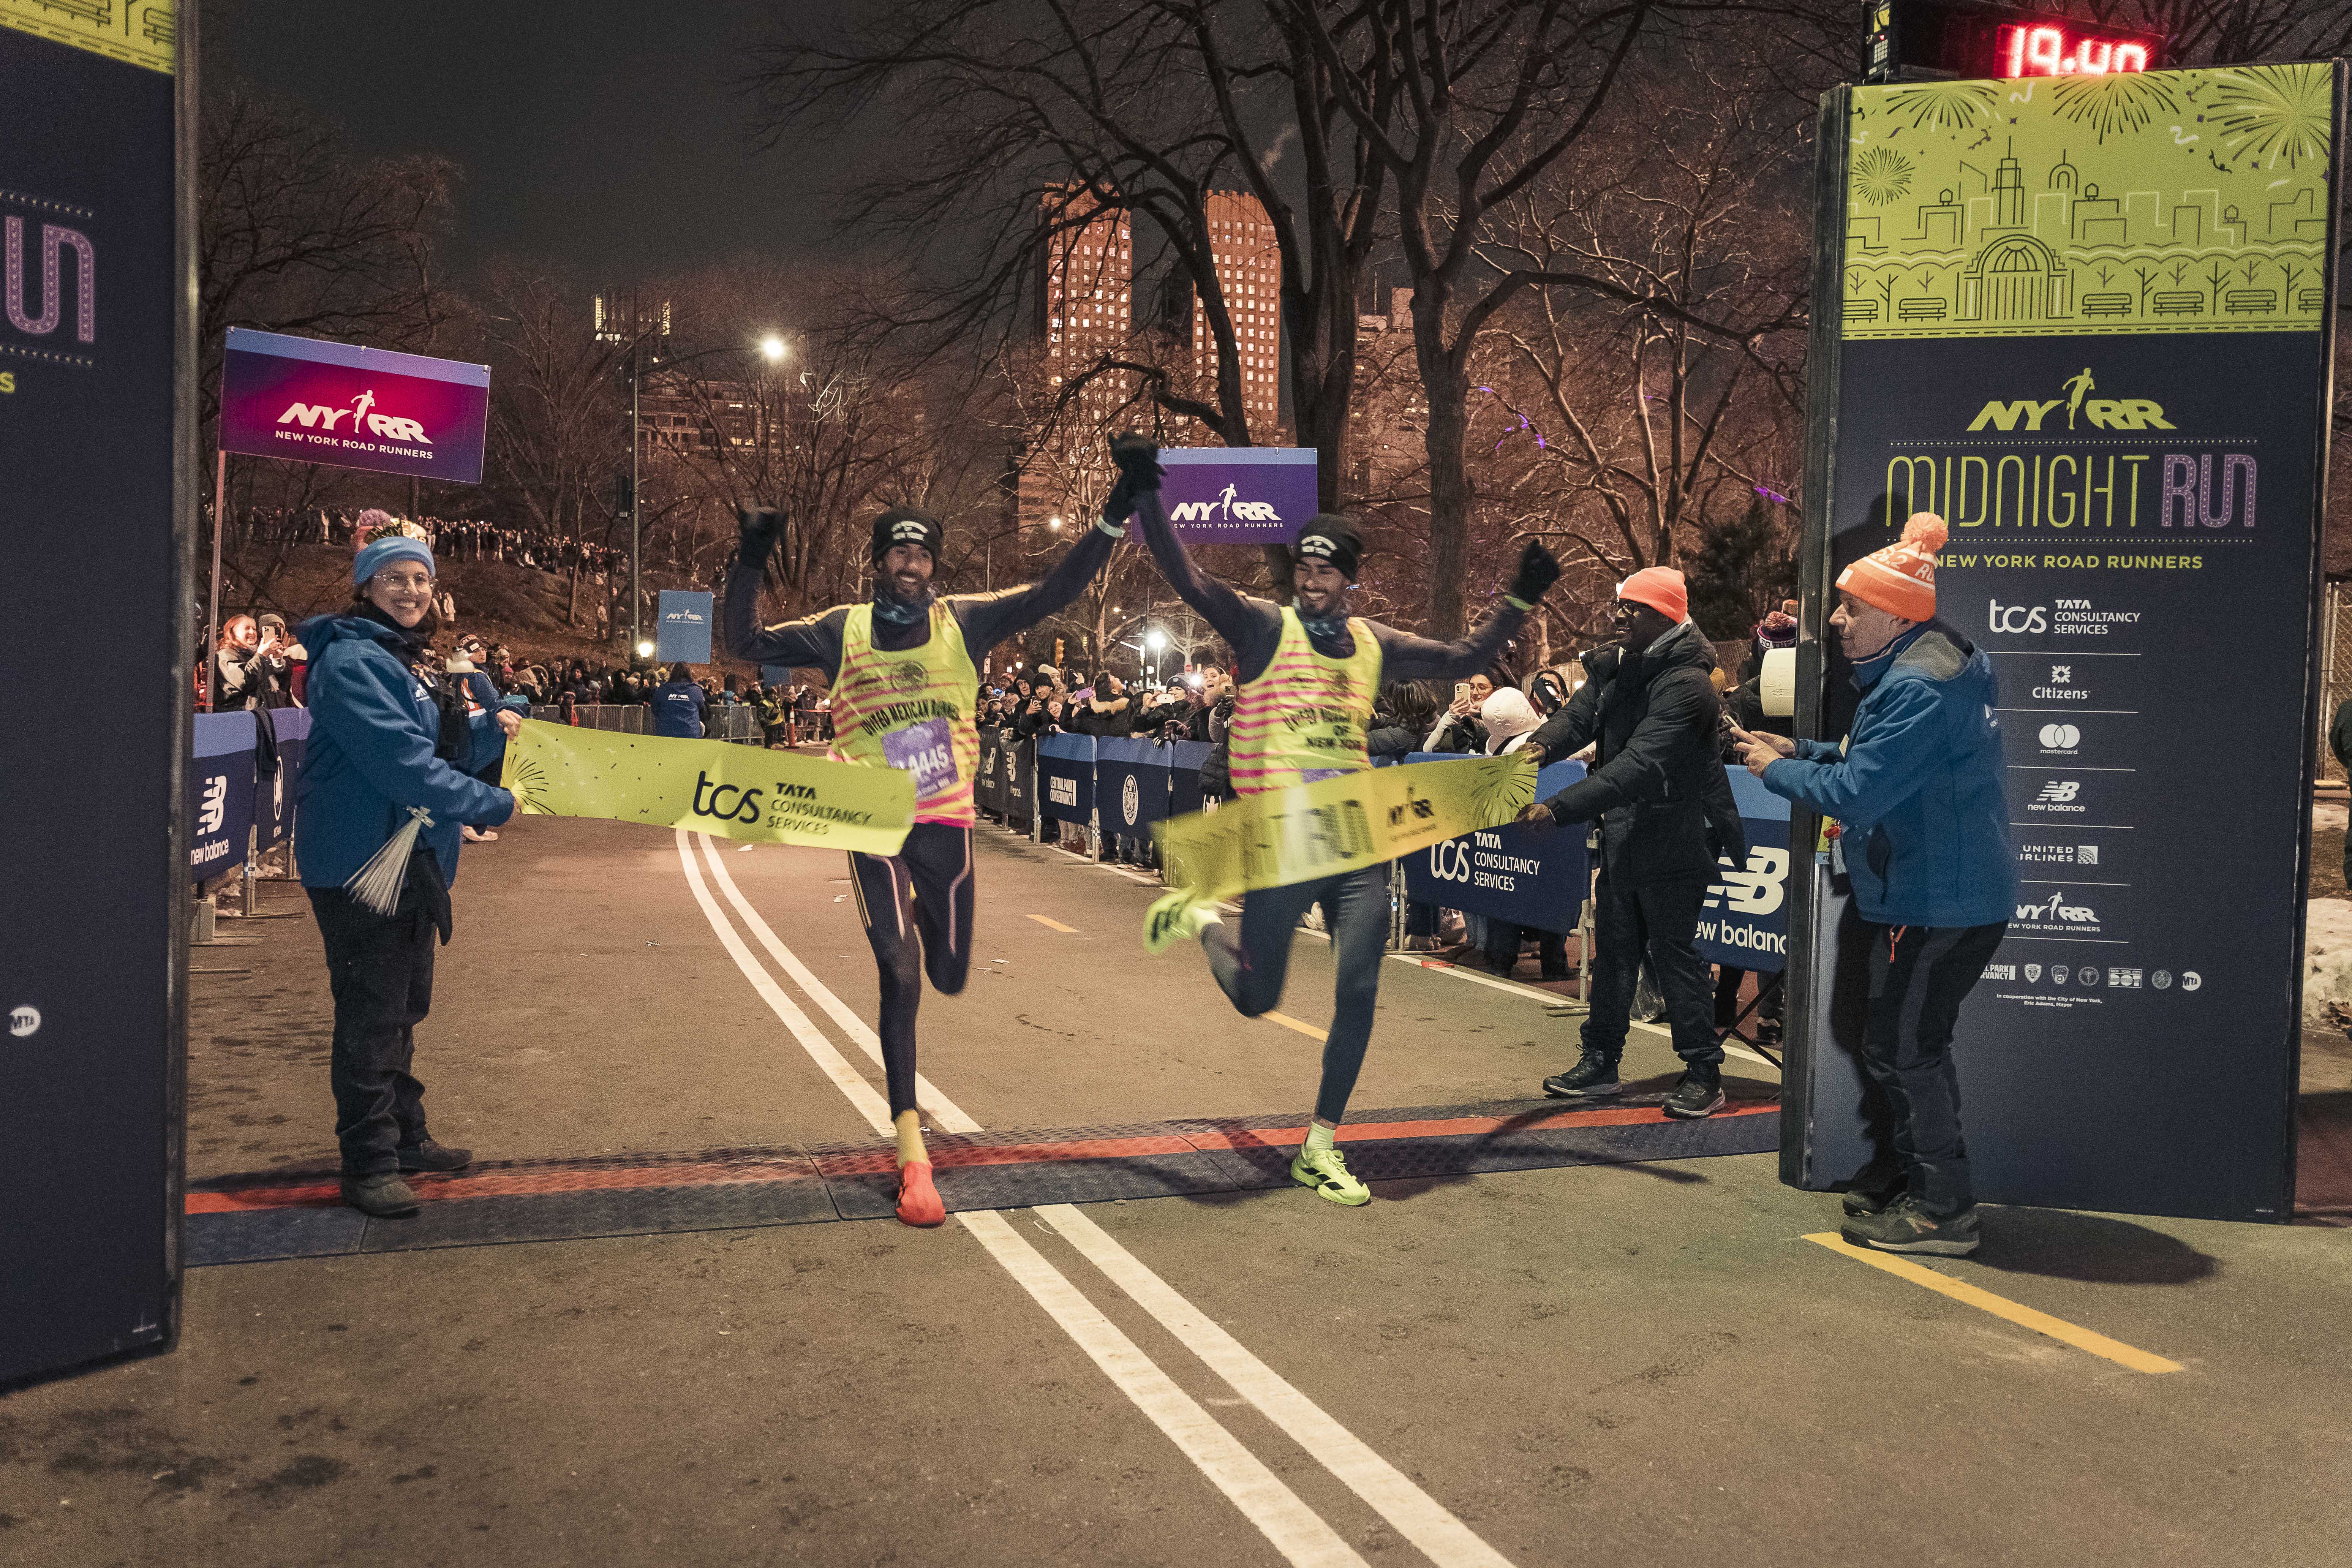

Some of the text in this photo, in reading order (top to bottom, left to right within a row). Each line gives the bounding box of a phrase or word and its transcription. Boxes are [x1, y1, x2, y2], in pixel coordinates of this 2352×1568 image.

[275, 430, 433, 460] NEW YORK ROAD RUNNERS
[1886, 453, 2257, 528] MIDNIGHT RUN
[1937, 555, 2203, 569] NEW YORK ROAD RUNNERS
[1989, 599, 2091, 633] tcs TATA
[2055, 612, 2140, 622] CONSULTANCY
[2054, 624, 2108, 634] SERVICES
[2032, 687, 2088, 699] Citizens
[692, 770, 817, 824] tcs TATA
[770, 798, 873, 825] CONSULTANCY
[2048, 803, 2085, 812] balance
[767, 815, 830, 835] SERVICES
[1475, 832, 1501, 849] TATA
[191, 839, 229, 865] new balance
[1475, 852, 1540, 875] CONSULTANCY
[1474, 871, 1514, 891] SERVICES
[1990, 964, 2009, 972] PARK
